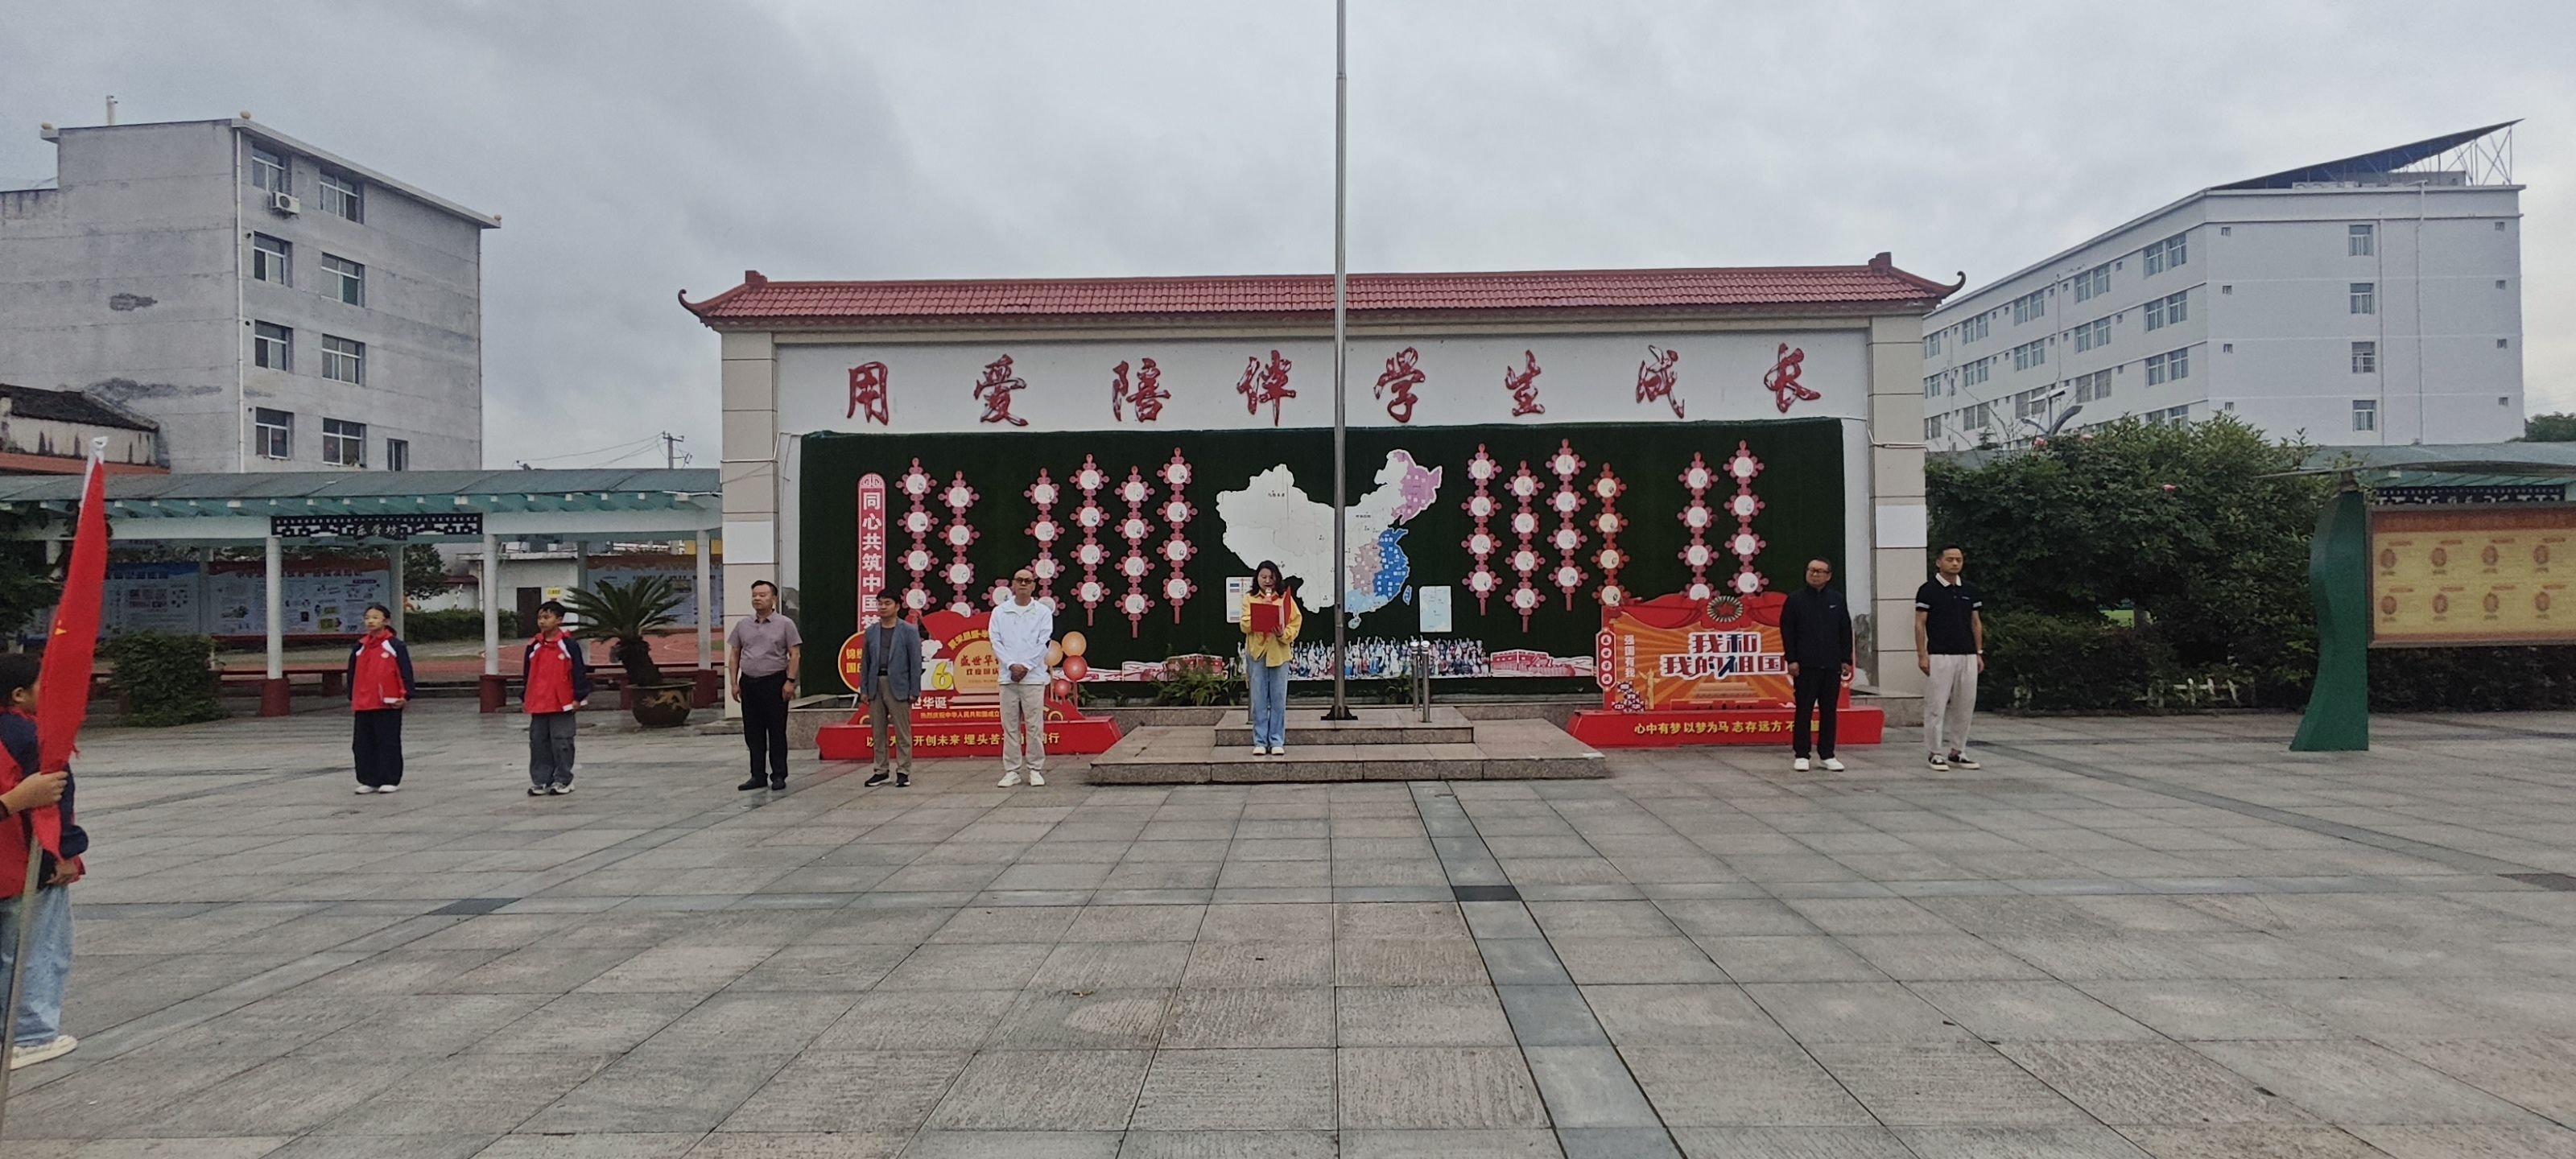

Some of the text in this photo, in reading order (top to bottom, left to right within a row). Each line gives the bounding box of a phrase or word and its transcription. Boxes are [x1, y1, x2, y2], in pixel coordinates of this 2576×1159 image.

[847, 342, 1821, 427] 用爱陪伴学生成长
[1690, 633, 1758, 654] 我和
[1664, 655, 1786, 679] 我的祖国
[1634, 723, 1681, 735] 心中有梦
[1684, 721, 1729, 733] 以梦为马
[1732, 720, 1782, 732] 志存远方
[914, 733, 960, 746] 开创未来
[964, 732, 1005, 745] 埋头苦
